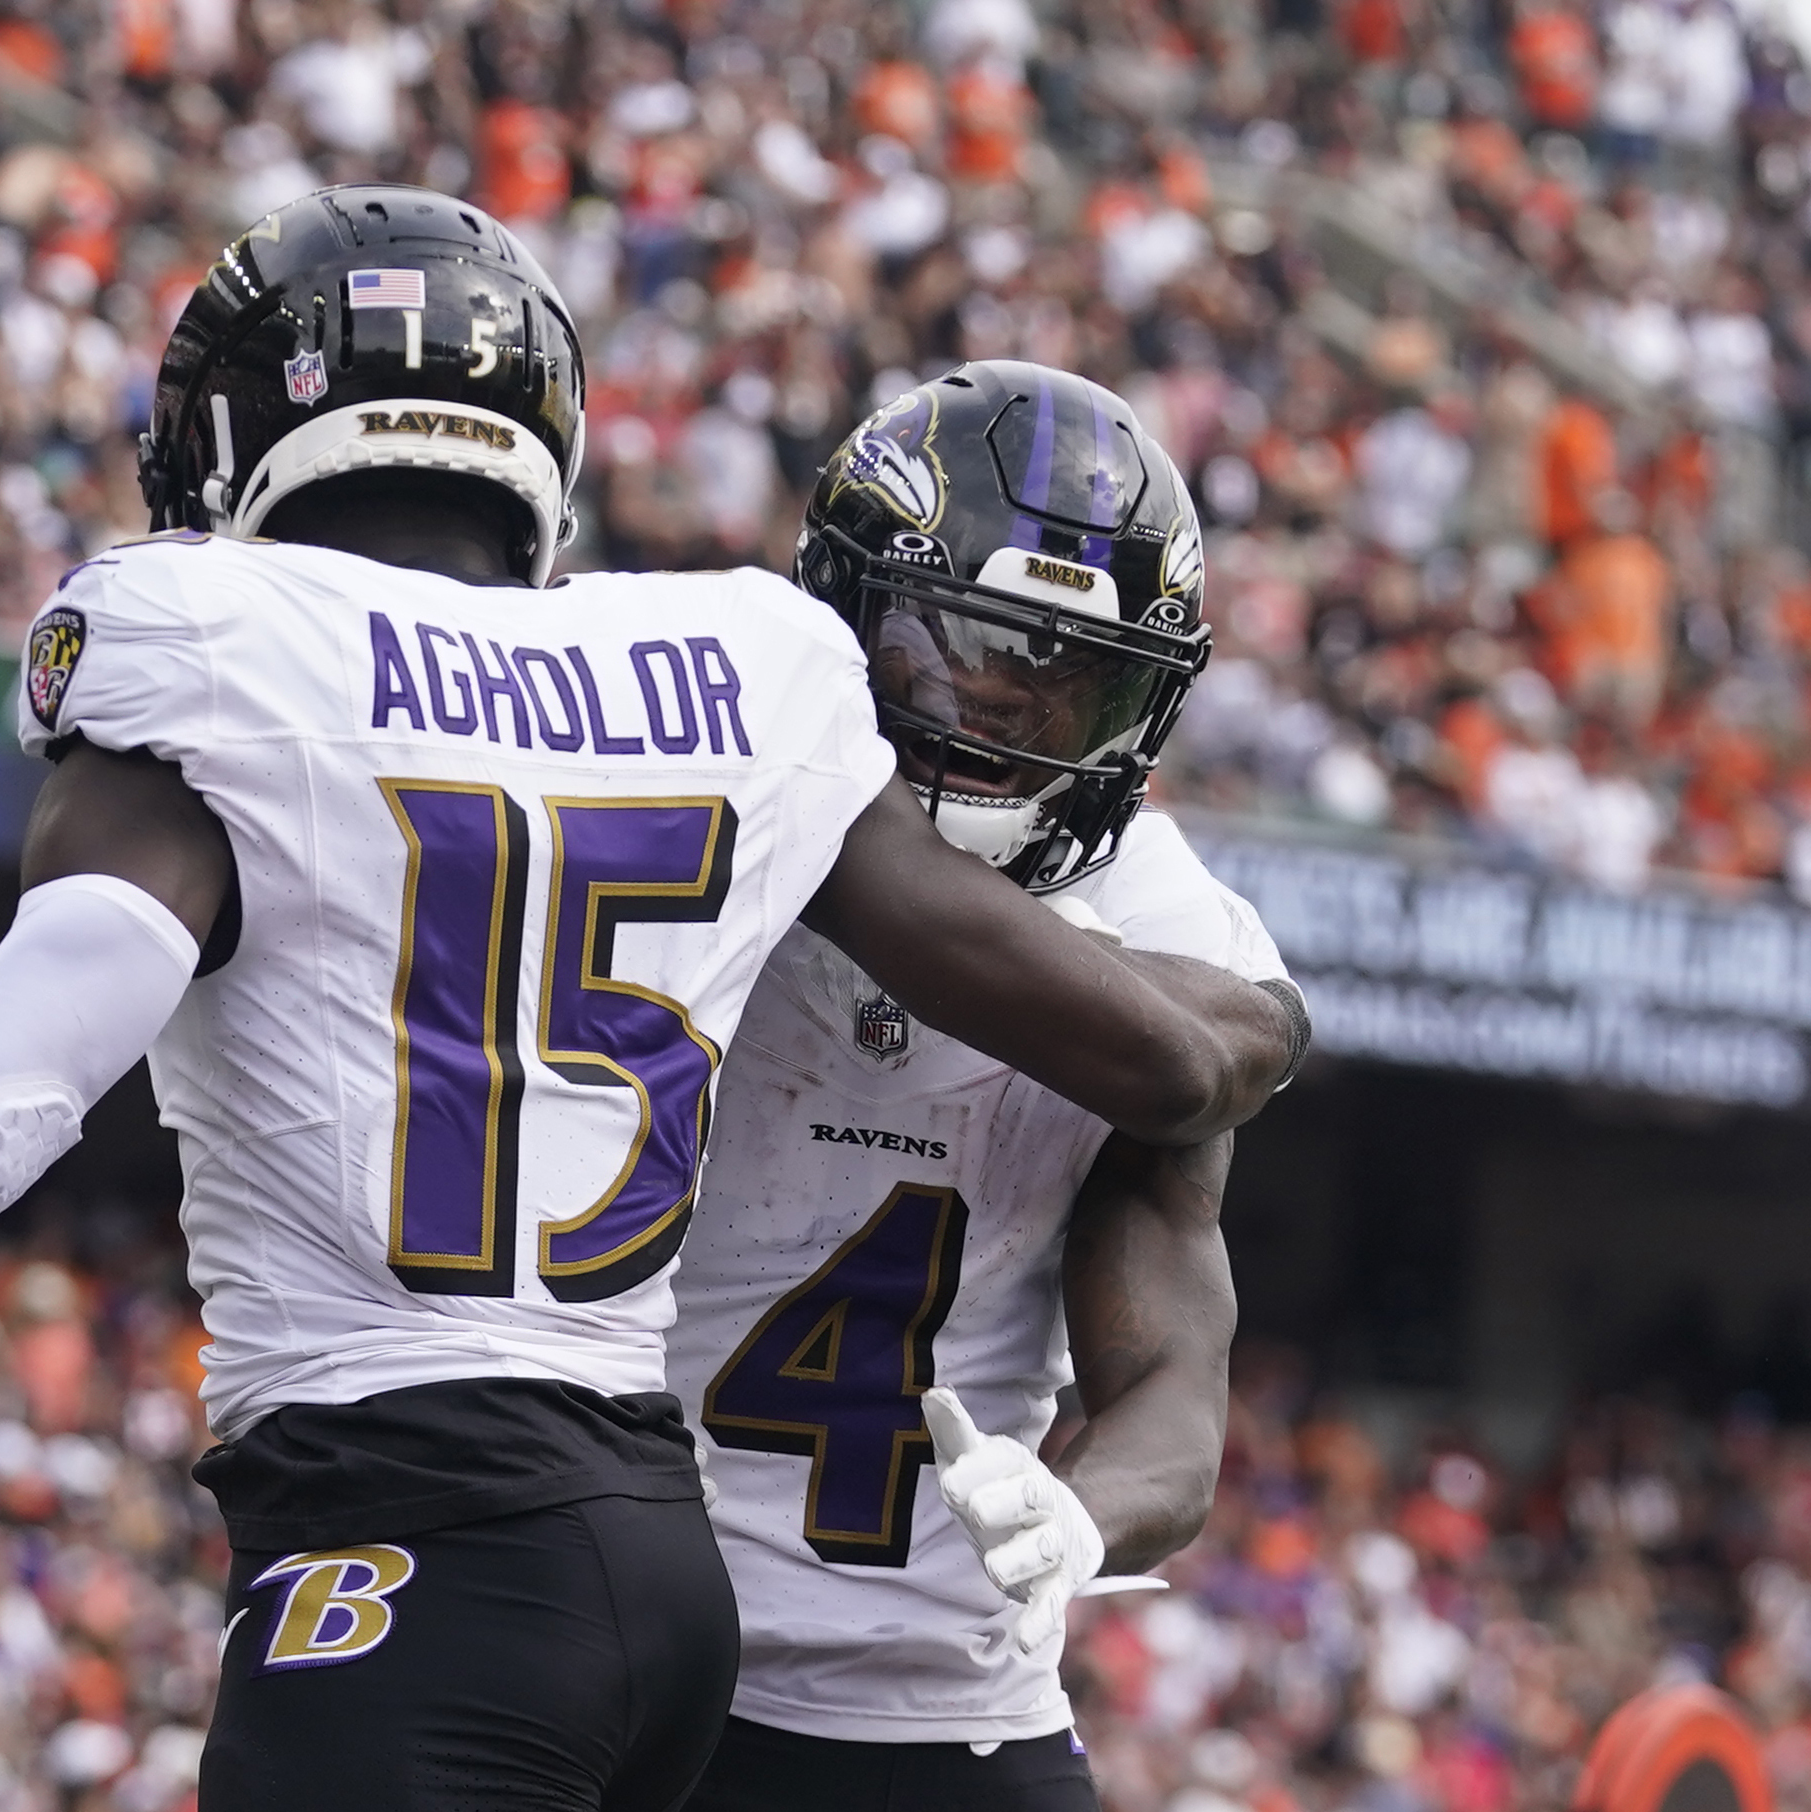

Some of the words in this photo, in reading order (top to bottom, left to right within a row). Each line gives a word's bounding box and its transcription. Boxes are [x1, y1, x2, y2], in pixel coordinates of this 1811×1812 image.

[357, 410, 517, 452] RAVENS
[882, 549, 943, 566] OAKLEY
[1024, 556, 1096, 592] RAVENS
[368, 610, 754, 758] AGHOLOR
[374, 776, 741, 1304] 15
[808, 1123, 949, 1160] RAVENS
[700, 1180, 970, 1568] 4
[246, 1542, 420, 1680] B
